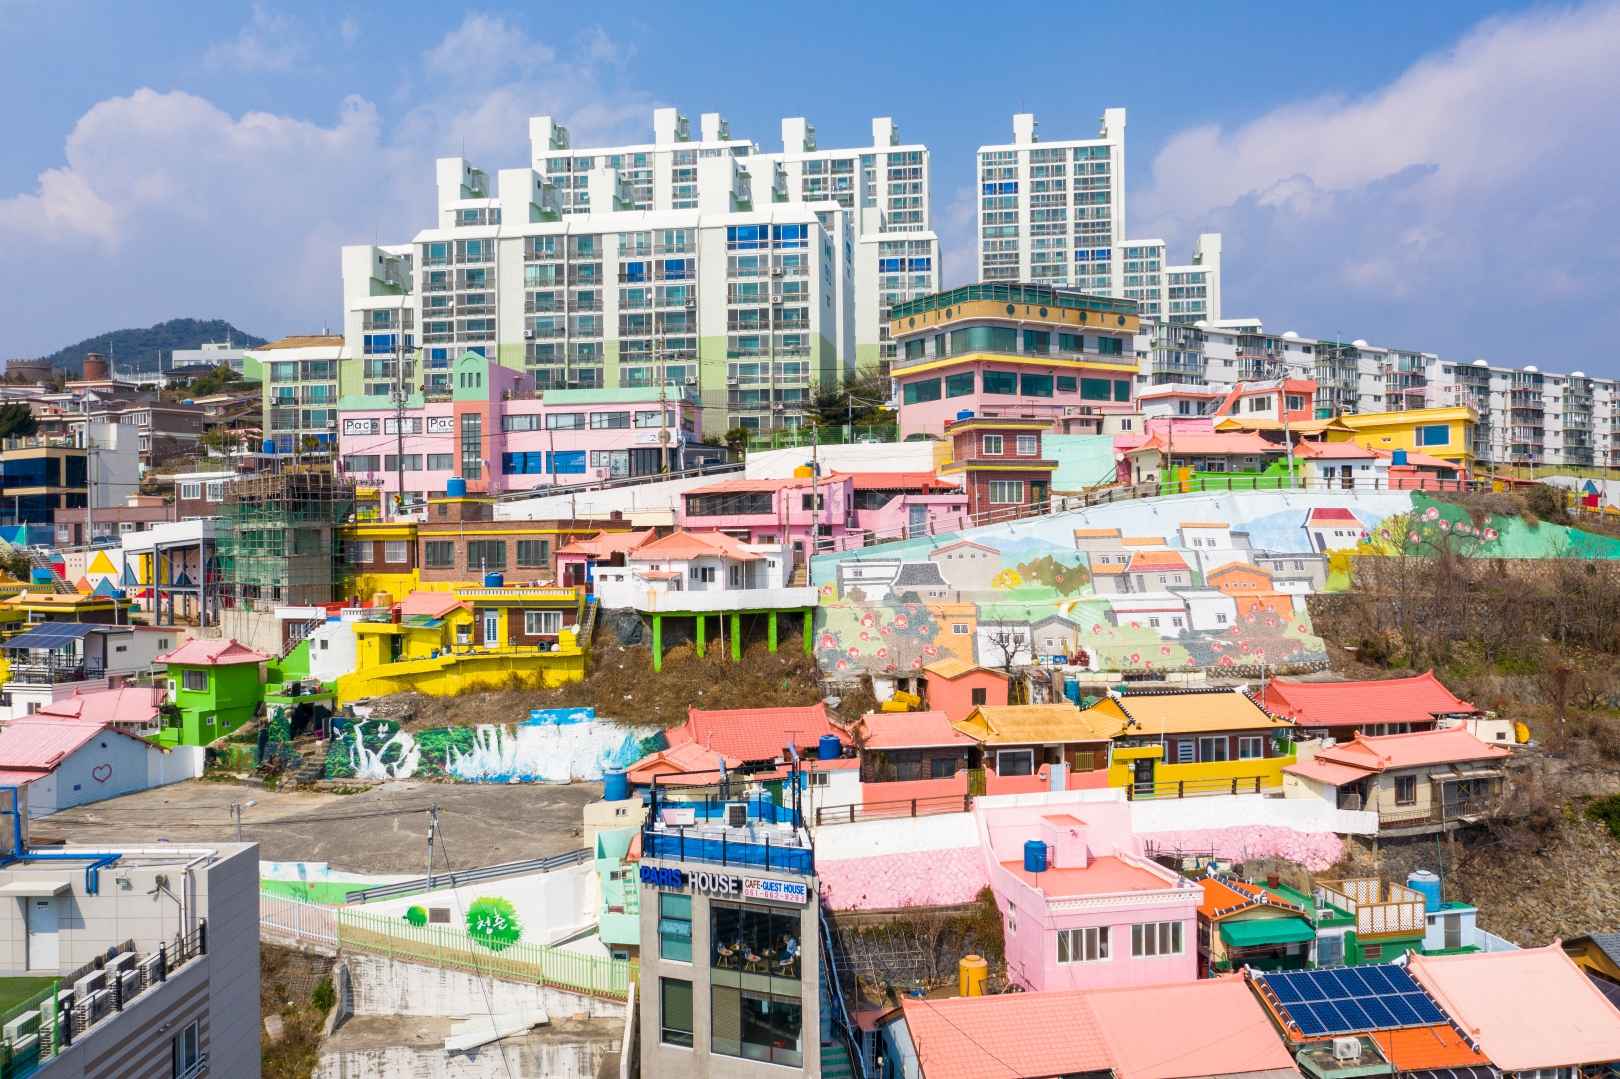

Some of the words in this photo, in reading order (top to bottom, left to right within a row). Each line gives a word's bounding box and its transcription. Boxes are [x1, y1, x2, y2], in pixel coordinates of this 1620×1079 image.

[640, 865, 682, 888] PARIS
[688, 871, 738, 894] HOUSE
[784, 884, 805, 895] HOUSE
